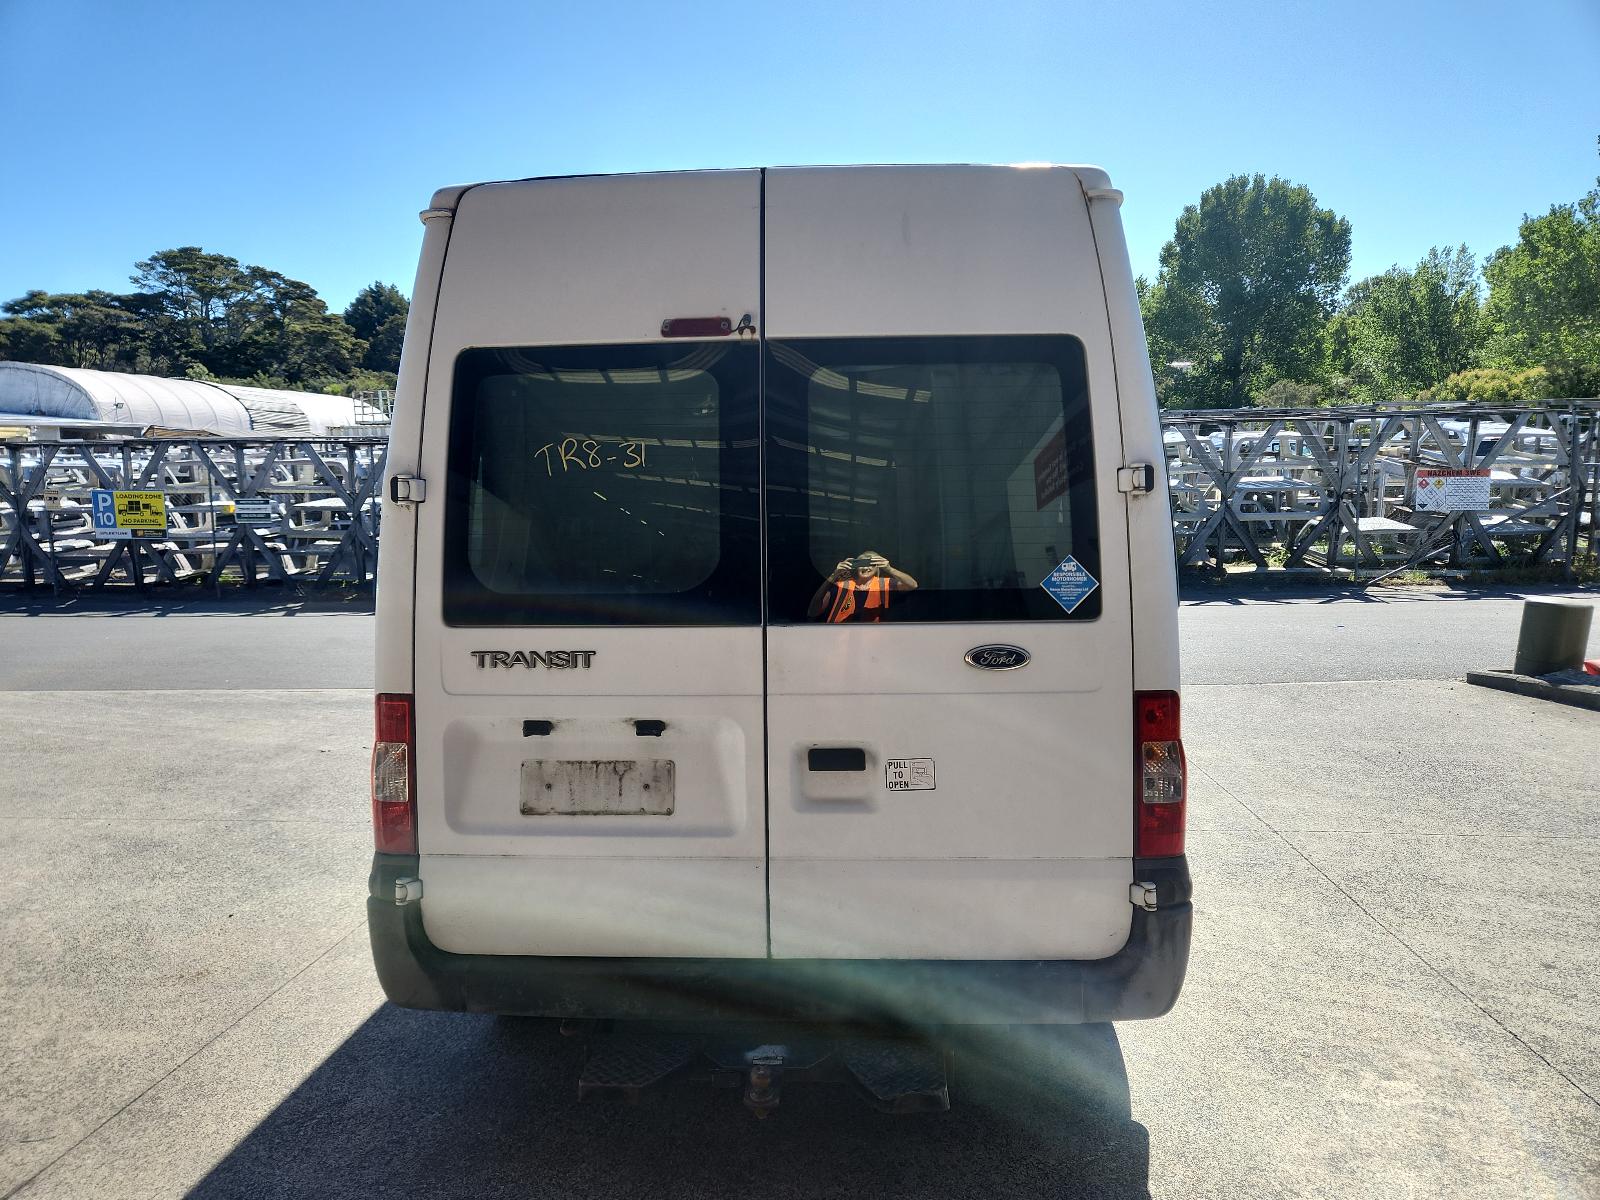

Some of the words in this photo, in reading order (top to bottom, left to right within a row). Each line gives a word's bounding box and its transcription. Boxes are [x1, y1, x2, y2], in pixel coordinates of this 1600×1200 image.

[534, 438, 646, 476] TR8-31
[1427, 469, 1463, 477] HAZCHEM
[97, 493, 112, 512] P
[96, 512, 115, 526] 10
[470, 650, 597, 669] TRANSIT
[980, 650, 1016, 665] Ford
[888, 761, 908, 769] PULL
[893, 770, 904, 779] TO
[888, 780, 909, 789] OPEN
